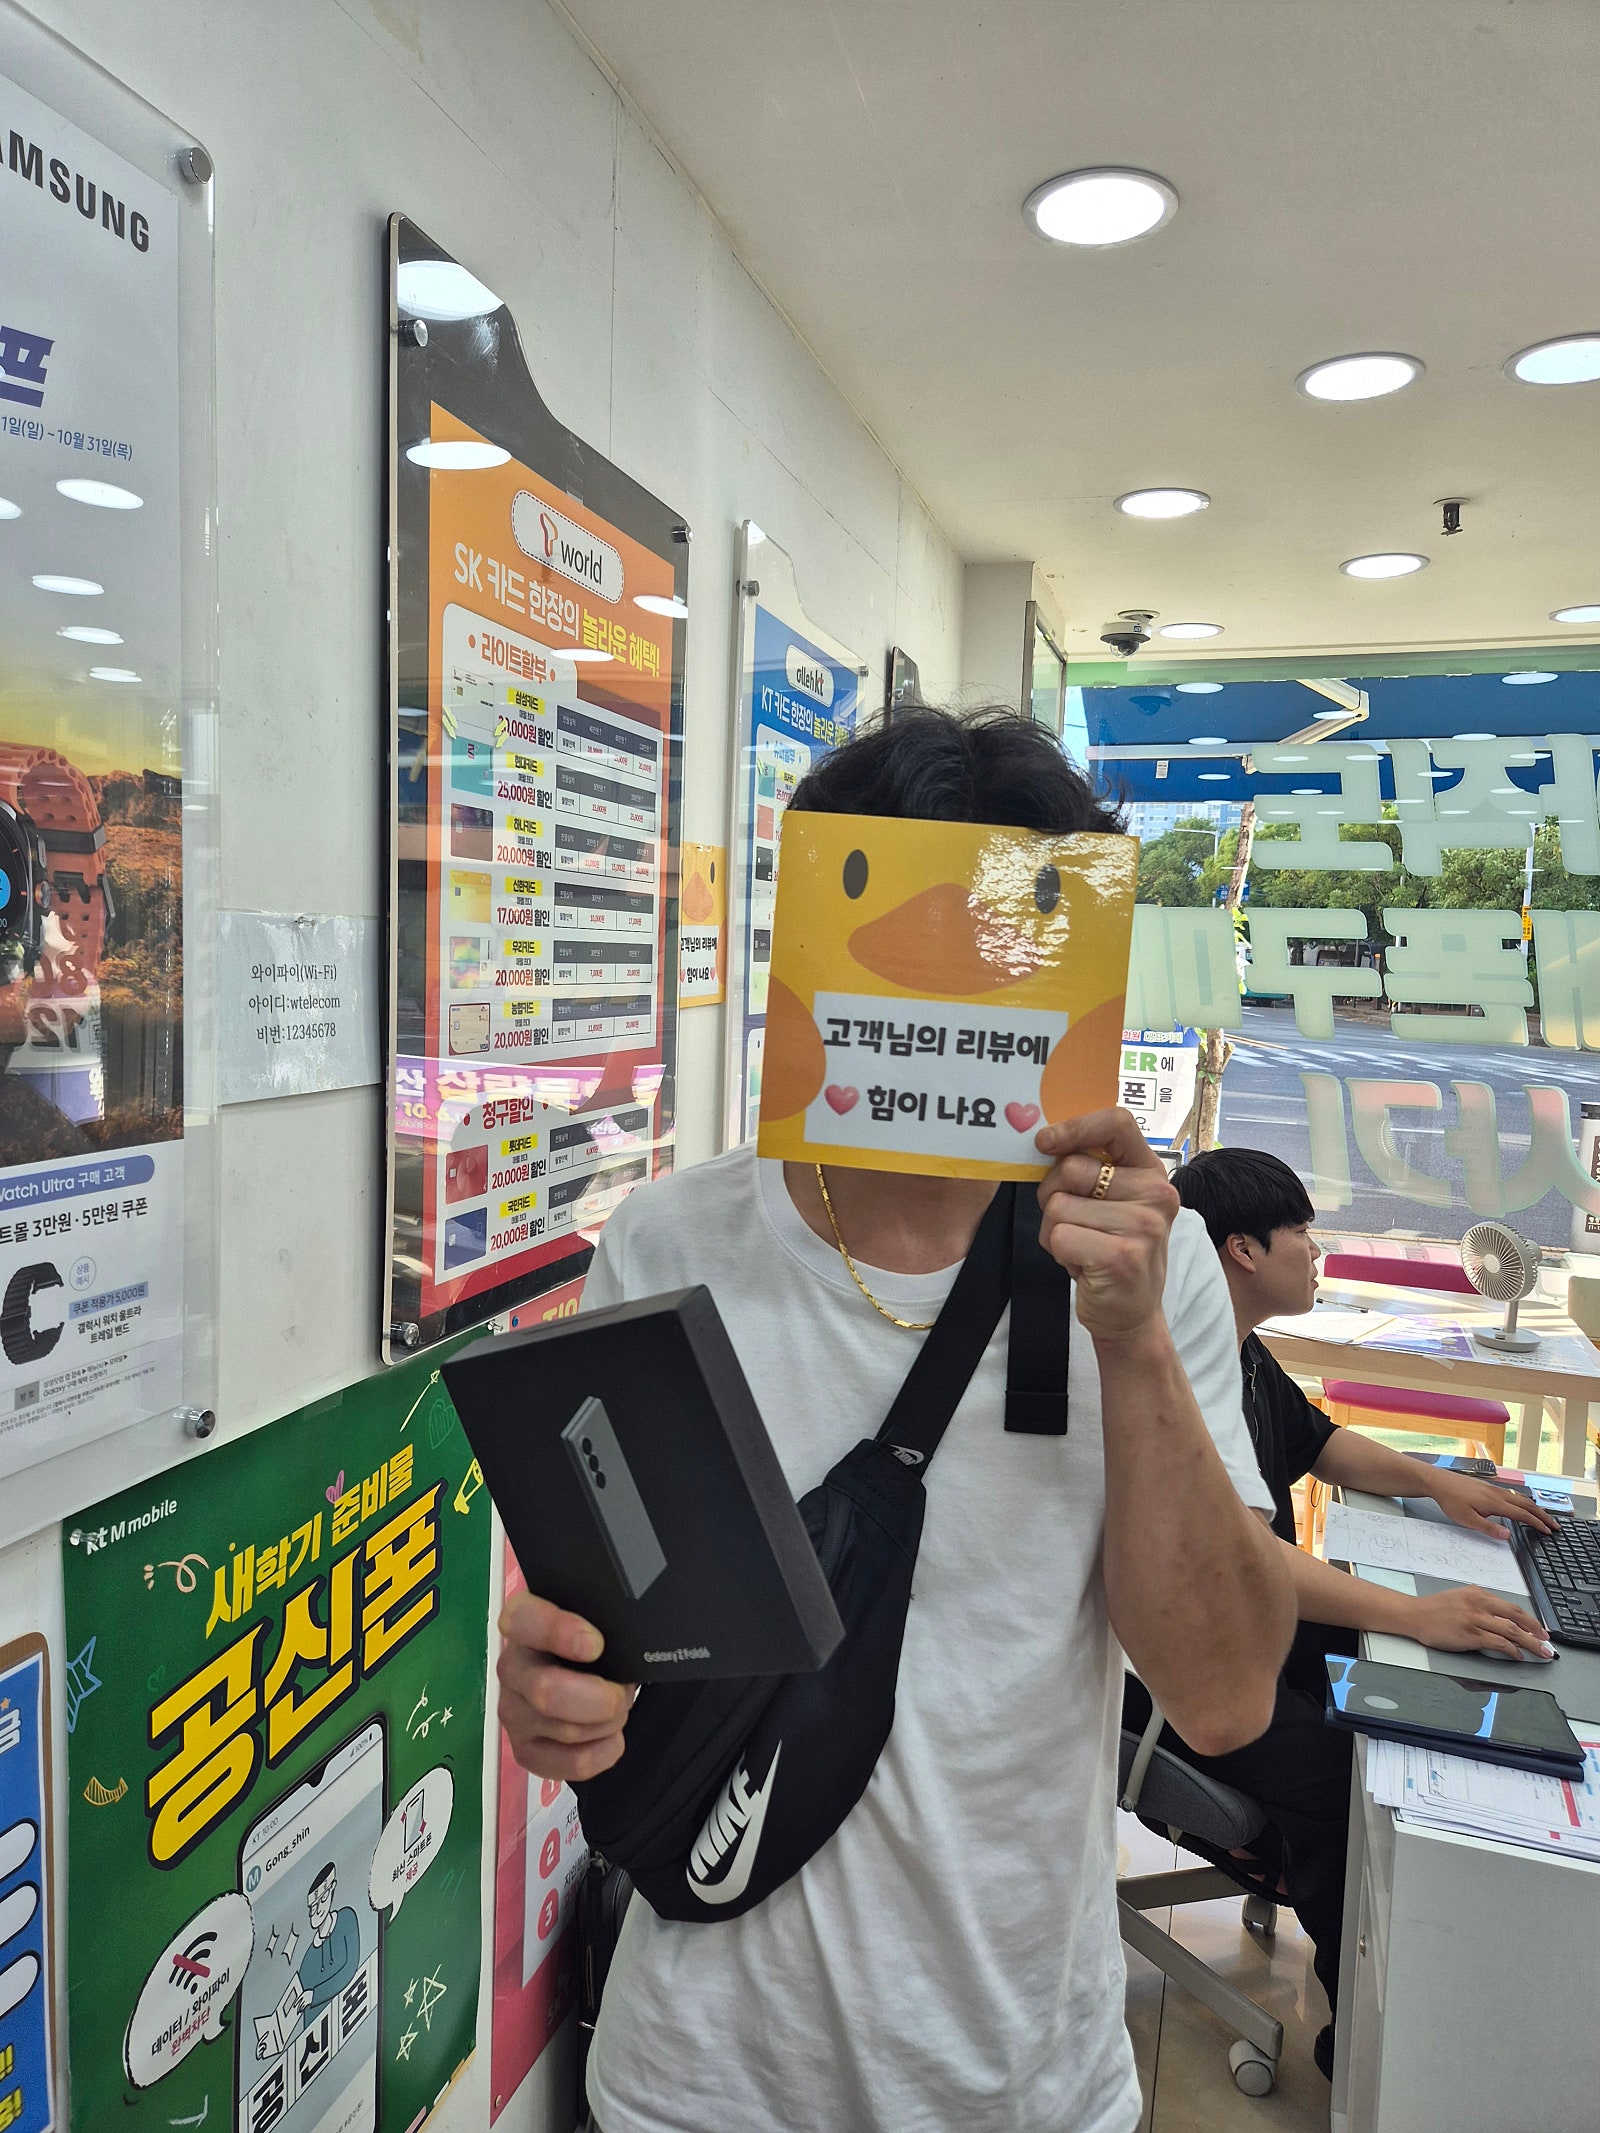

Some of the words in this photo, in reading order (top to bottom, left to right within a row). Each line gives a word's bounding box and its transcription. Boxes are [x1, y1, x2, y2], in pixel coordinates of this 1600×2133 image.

[0, 130, 150, 253] MSUNG
[57, 429, 85, 450] 10월
[87, 436, 133, 462] 31일(목)
[560, 541, 602, 585] world
[454, 542, 483, 593] SK
[487, 557, 525, 615] 카드
[528, 580, 580, 641] 한장의
[582, 608, 627, 663] 놀라운
[630, 633, 660, 679] 혜택!
[481, 632, 548, 684] 라이트할부
[516, 691, 538, 710] 삼성카드
[761, 684, 774, 713] KT
[774, 691, 790, 723] 카드
[791, 700, 813, 735] 한장의
[538, 727, 553, 749] 할인
[497, 780, 536, 806] 25,000원
[537, 789, 552, 809] 할인
[497, 845, 535, 867] 20,000원
[536, 850, 551, 869] 할인
[497, 907, 533, 926] 17,000원
[534, 909, 549, 927] 할인
[512, 941, 535, 953] 우리카드
[251, 963, 337, 983] 와이파이(Wi-Fi)
[495, 968, 533, 987] 20,000원
[535, 968, 549, 986] 할인
[248, 994, 341, 1014] 아이디:wtelecom
[256, 1022, 336, 1045] 비번:12345678
[494, 1029, 532, 1049] 20,000원
[533, 1027, 548, 1046] 할인
[823, 1017, 945, 1057] 고객님의
[956, 1028, 1050, 1065] 리뷰에
[1122, 1050, 1158, 1072] ER
[1161, 1057, 1174, 1071] 에
[867, 1085, 927, 1122] 힘이
[937, 1095, 997, 1129] 나요
[1123, 1082, 1146, 1105] 폰
[1159, 1088, 1172, 1103] 을
[482, 1095, 534, 1130] 청구할인
[42, 1178, 75, 1195] Ultra
[78, 1170, 101, 1188] 구매
[103, 1165, 126, 1183] 고객
[491, 1163, 530, 1190] 20,000원
[530, 1158, 547, 1180] 할인
[32, 1211, 72, 1237] 3만원
[82, 1202, 119, 1226] 5만원
[121, 1197, 148, 1219] 쿠폰
[507, 1195, 531, 1213] 국민카드
[490, 1223, 529, 1251] 20,000원
[529, 1216, 545, 1238] 할인
[73, 1300, 89, 1315] 쿠폰
[115, 1284, 145, 1304] 5,000원
[78, 1317, 101, 1335] 갤럭시
[103, 1312, 118, 1327] 워치
[119, 1305, 142, 1322] 울트라
[110, 1521, 126, 1544] M
[127, 1499, 178, 1535] mobile
[206, 1510, 322, 1639] 새학기
[331, 1443, 414, 1548] 준비물
[148, 1482, 446, 1864] 공신폰
[690, 1750, 766, 1882] NIKE
[265, 1826, 310, 1872] Gong_shin
[406, 1832, 432, 1867] 스마트폰
[546, 1840, 555, 1868] 2
[544, 1900, 553, 1928] 3
[152, 2014, 182, 2056] 데이터
[192, 1967, 230, 2016] 와이파이
[171, 2004, 211, 2057] 완벽차단
